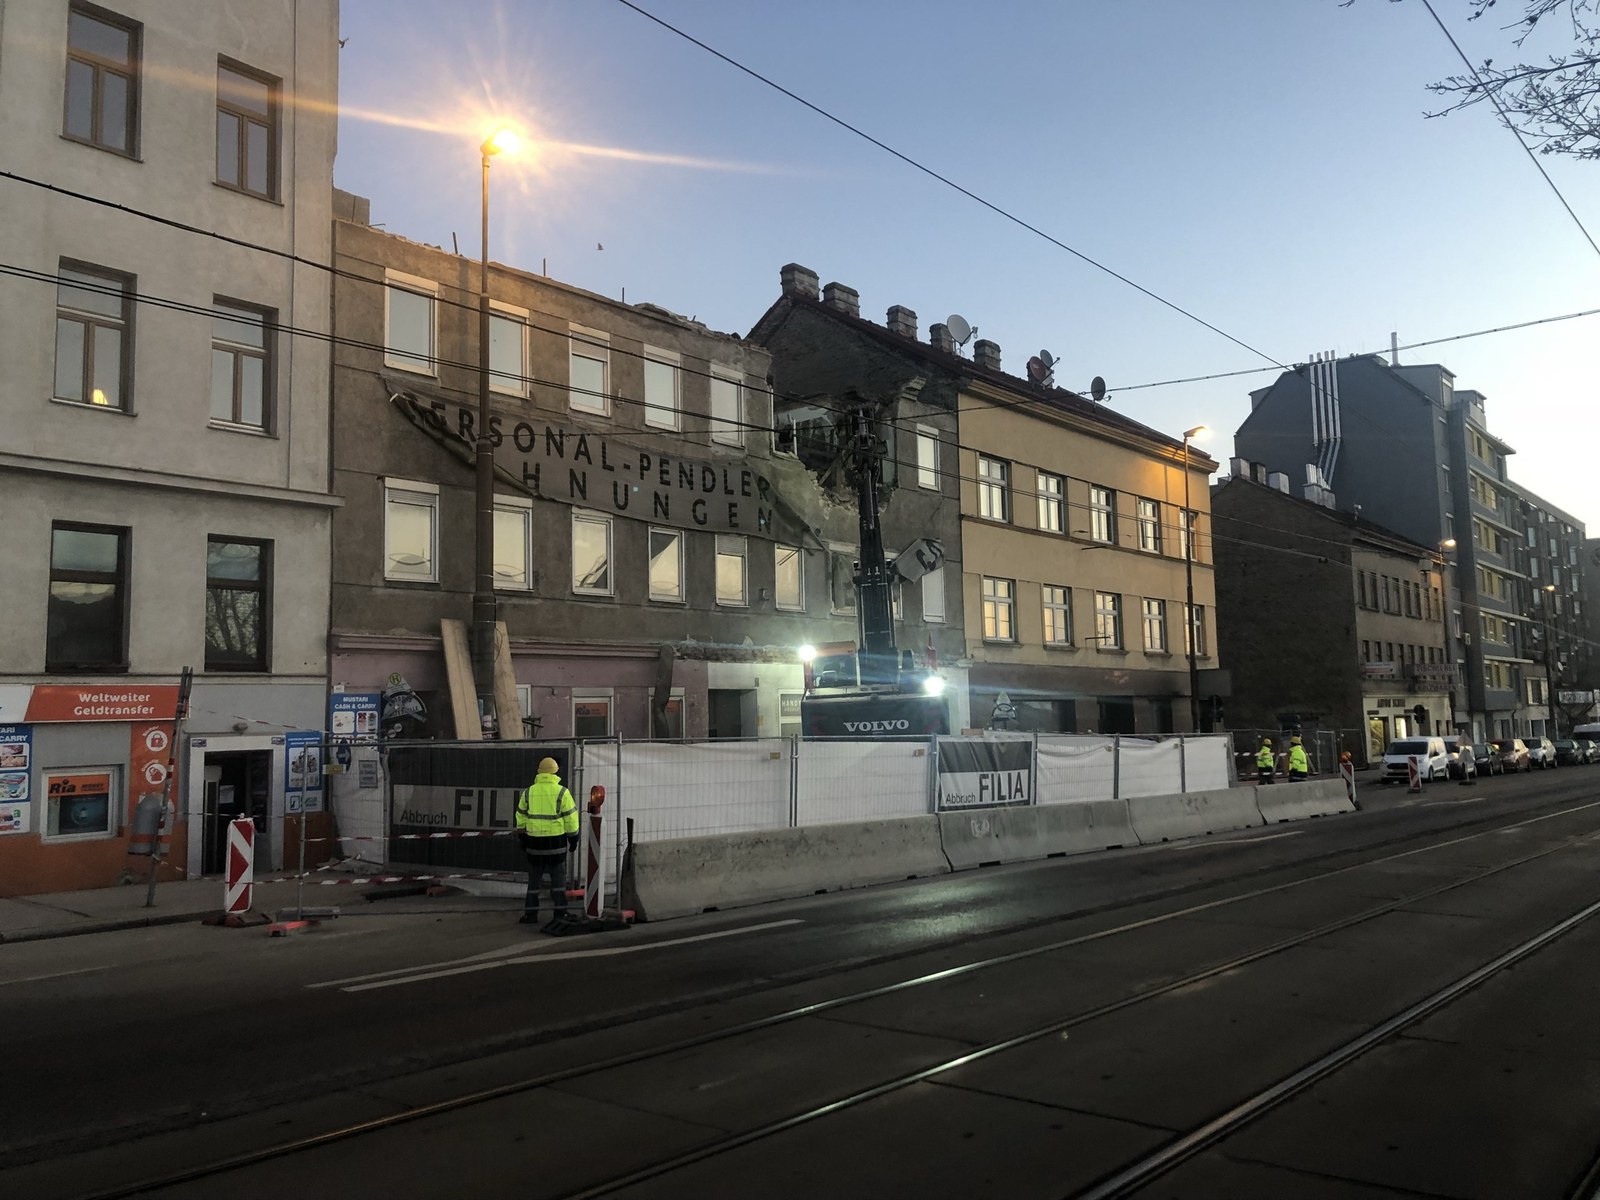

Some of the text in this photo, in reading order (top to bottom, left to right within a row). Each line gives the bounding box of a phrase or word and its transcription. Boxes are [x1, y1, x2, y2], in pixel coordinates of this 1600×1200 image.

[79, 693, 151, 702] Weltweiter
[74, 705, 154, 715] Geldtransfer
[575, 705, 590, 715] Ria
[843, 719, 909, 732] VOLVO
[49, 779, 76, 794] Ria
[945, 772, 1024, 804] Abbruch FILIA
[400, 809, 447, 826] Abbruch
